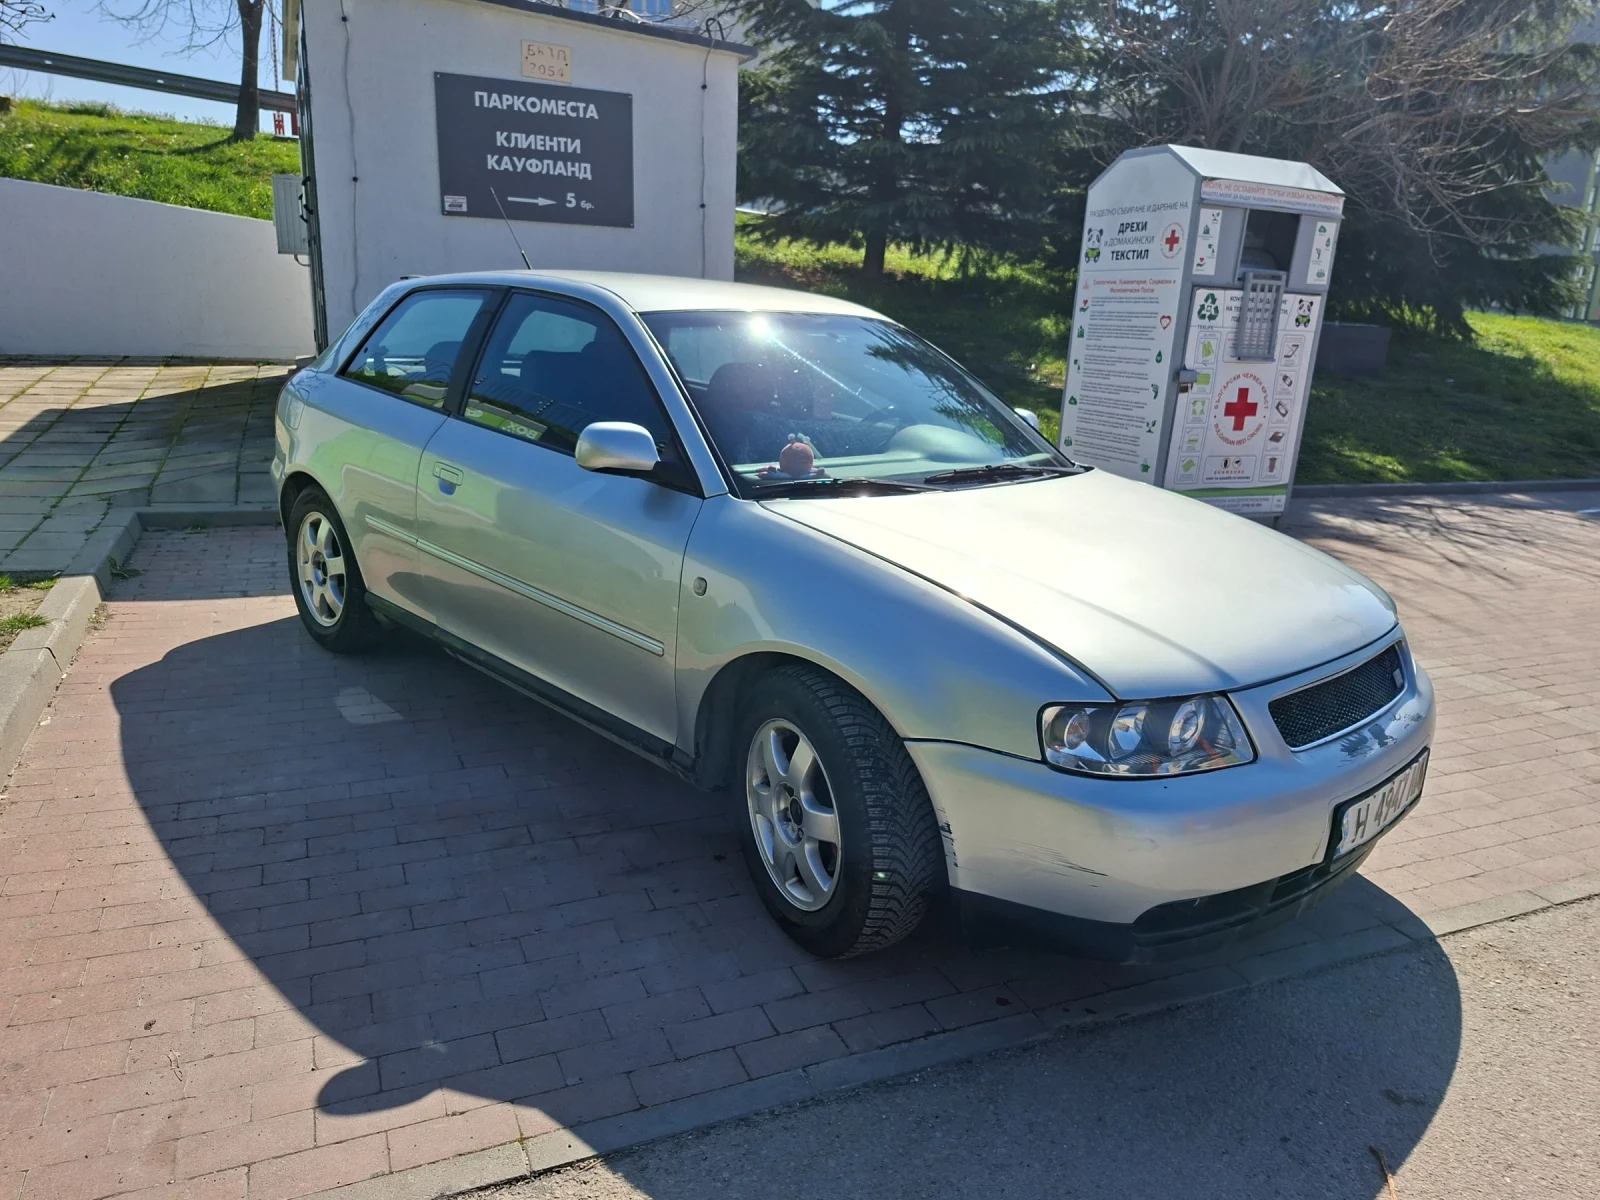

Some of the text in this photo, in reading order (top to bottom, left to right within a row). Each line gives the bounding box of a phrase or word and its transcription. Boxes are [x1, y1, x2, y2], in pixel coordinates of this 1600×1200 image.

[529, 62, 564, 77] 2054
[474, 90, 599, 120] ПАРКОМЕСТА
[496, 131, 581, 154] КЛИЕНТИ
[487, 154, 592, 180] КАУФЛАНД
[565, 192, 595, 210] 5 бр.
[1090, 208, 1116, 217] РАЗДЕЛНО
[1117, 204, 1146, 215] СЪБИРАНЕ
[1151, 202, 1178, 213] ДАРЕНИЕ
[1179, 201, 1188, 209] НА
[1117, 221, 1148, 236] ДРЕХИ
[1108, 235, 1155, 247] ДОМАКИНСКИ
[1111, 249, 1149, 261] ТЕКСТИЛ
[1214, 374, 1240, 409] БЪЛГАРСКИ
[1242, 372, 1263, 386] ЧЕРВЕН
[1214, 422, 1235, 446] BULGARIAN
[1236, 438, 1247, 446] RED
[1352, 803, 1370, 844] H
